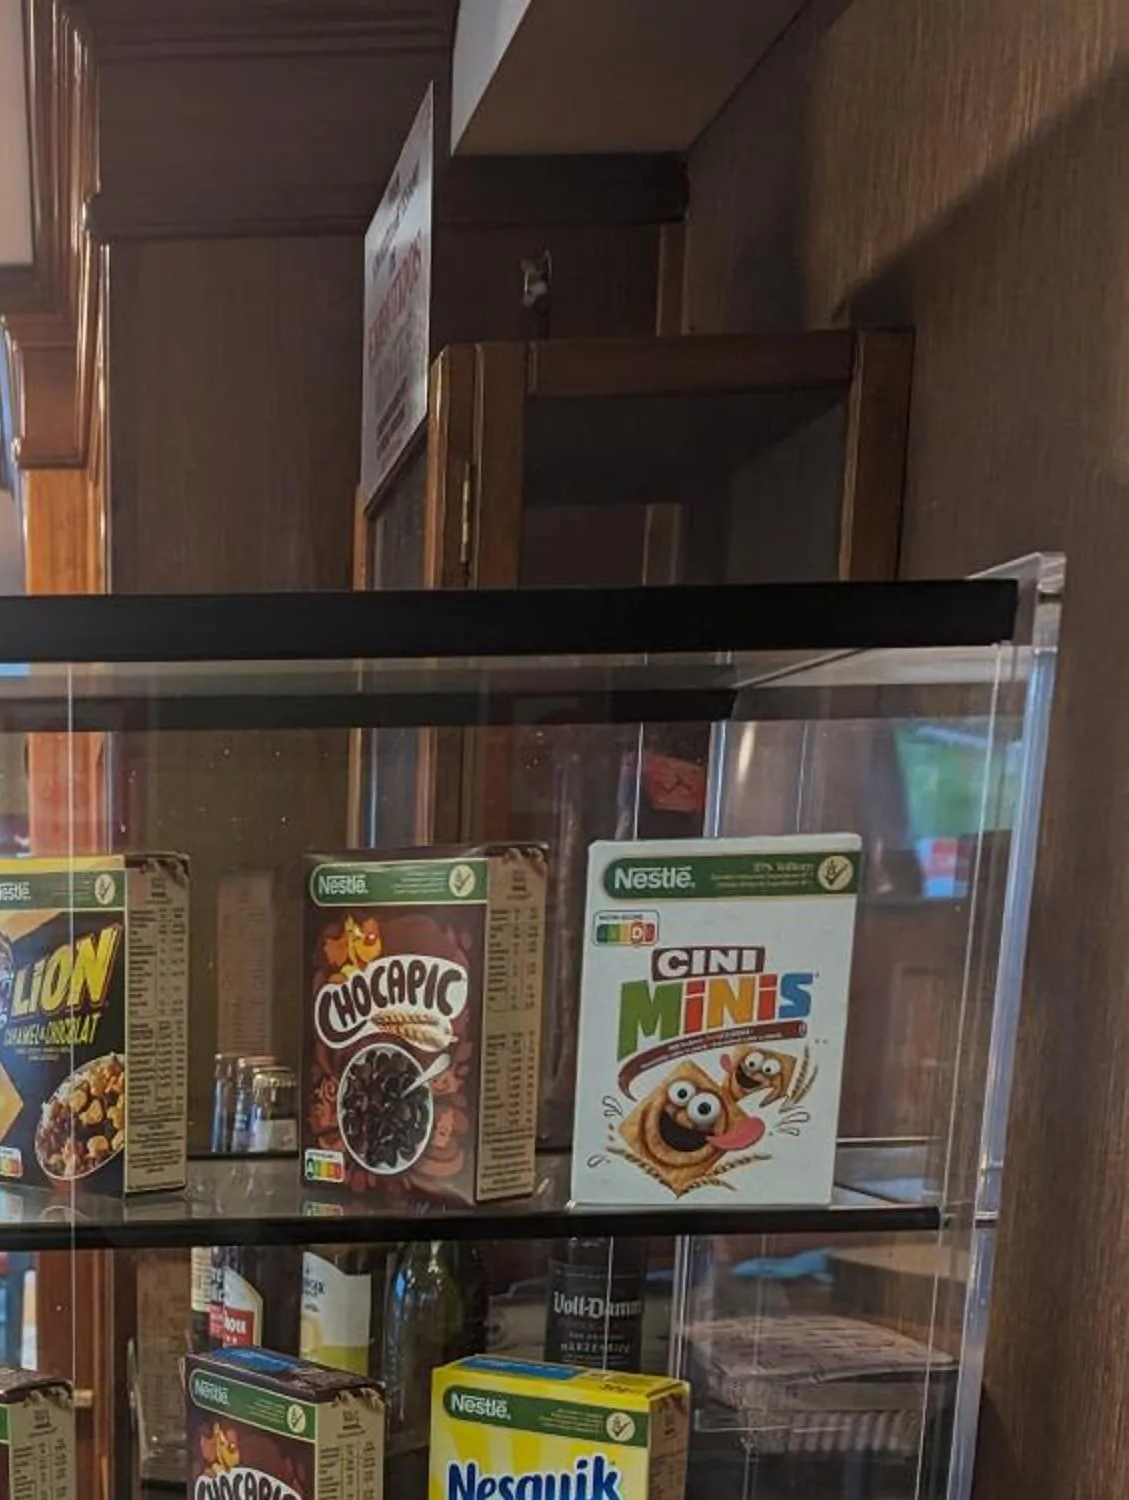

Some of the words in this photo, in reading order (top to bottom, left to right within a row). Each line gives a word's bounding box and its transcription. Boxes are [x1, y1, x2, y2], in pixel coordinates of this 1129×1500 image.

[614, 866, 695, 890] Nestlé
[657, 949, 757, 978] CINI
[318, 958, 462, 1043] CHOCAPIC
[451, 1393, 511, 1420] Nestlé
